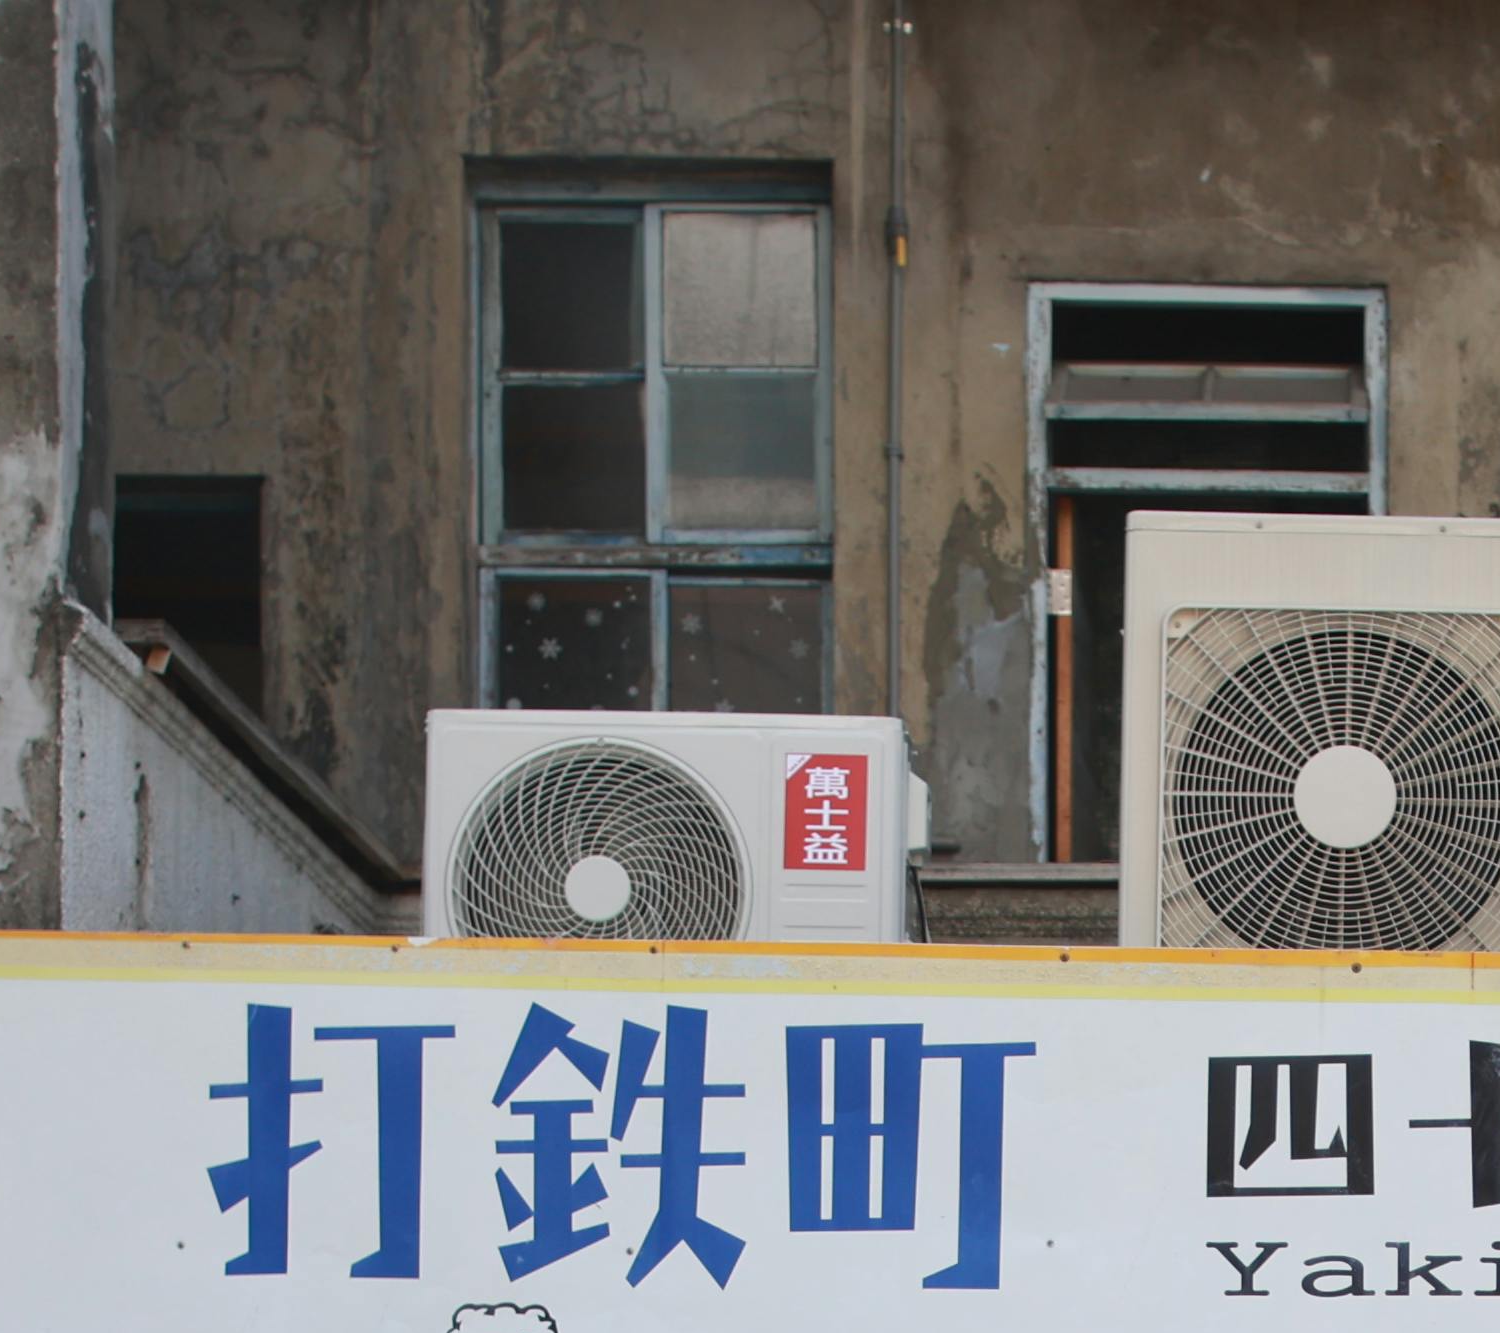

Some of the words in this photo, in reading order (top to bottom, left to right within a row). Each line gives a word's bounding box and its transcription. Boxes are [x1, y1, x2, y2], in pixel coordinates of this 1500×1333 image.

[803, 767, 850, 864] 萬士益
[206, 1002, 1037, 1290] 打鉄町
